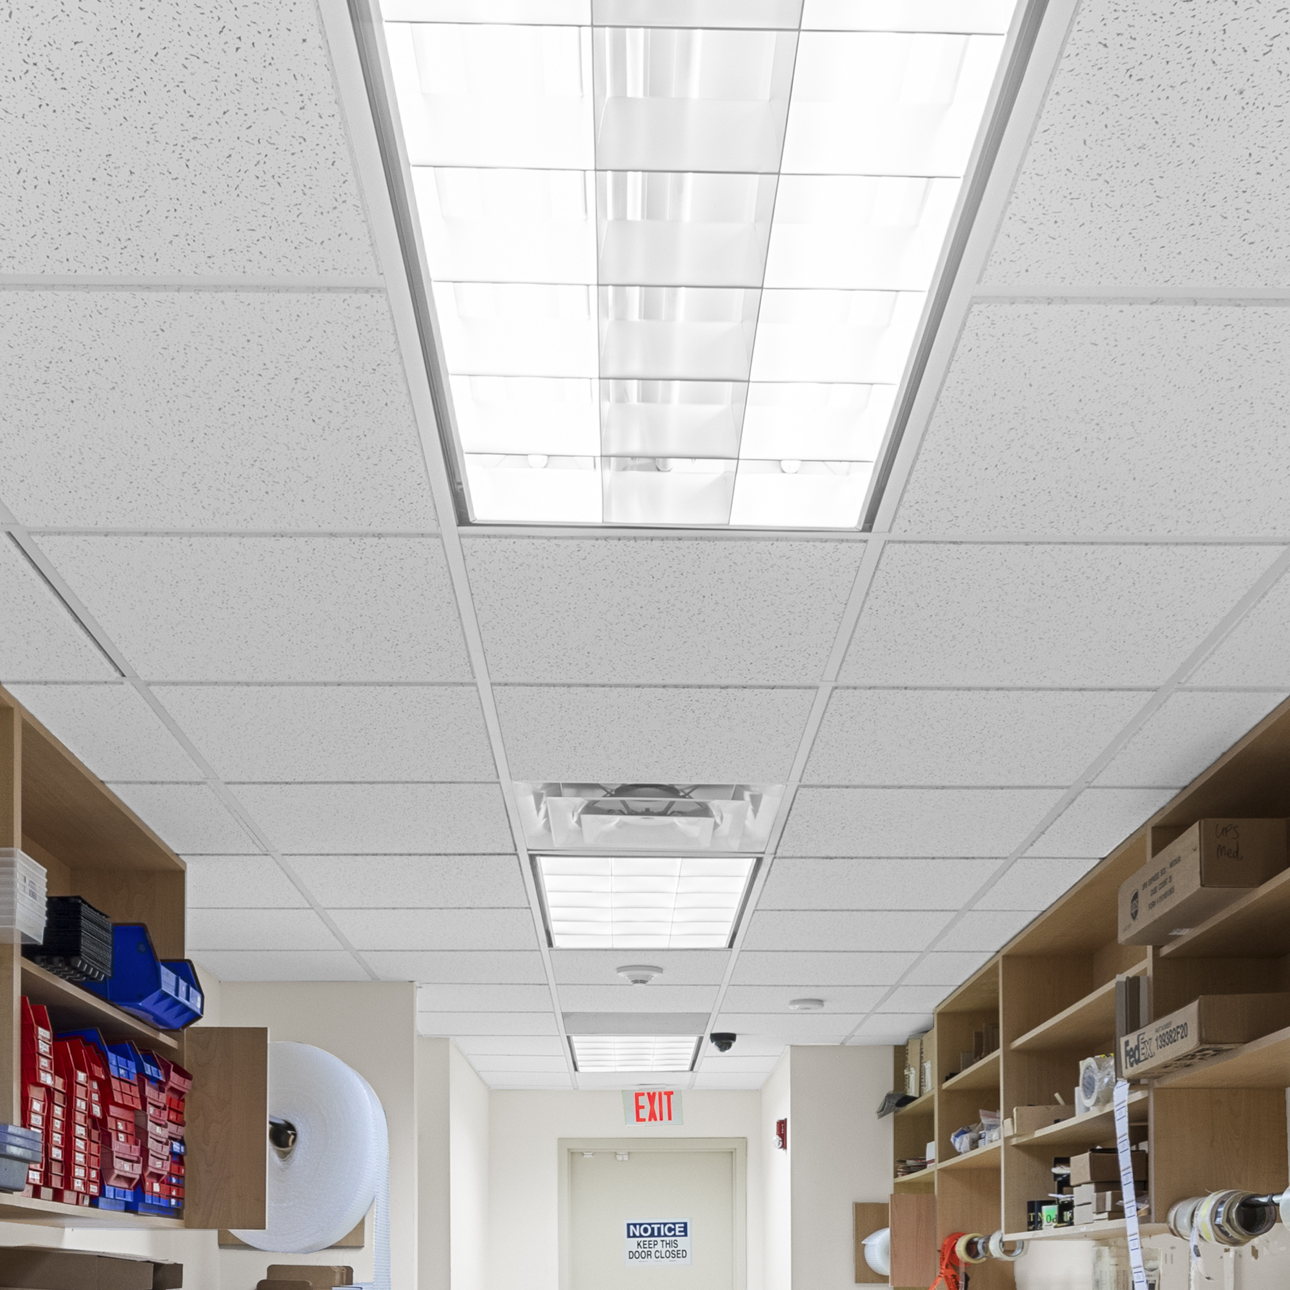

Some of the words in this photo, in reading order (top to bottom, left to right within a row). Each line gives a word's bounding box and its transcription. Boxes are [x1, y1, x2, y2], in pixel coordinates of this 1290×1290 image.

[634, 1091, 674, 1122] EXIT
[629, 1223, 685, 1237] NOTICE
[636, 1240, 658, 1249] KEEP
[660, 1239, 679, 1249] THIS
[628, 1250, 652, 1260] DOOR
[654, 1249, 687, 1259] CLOSED
